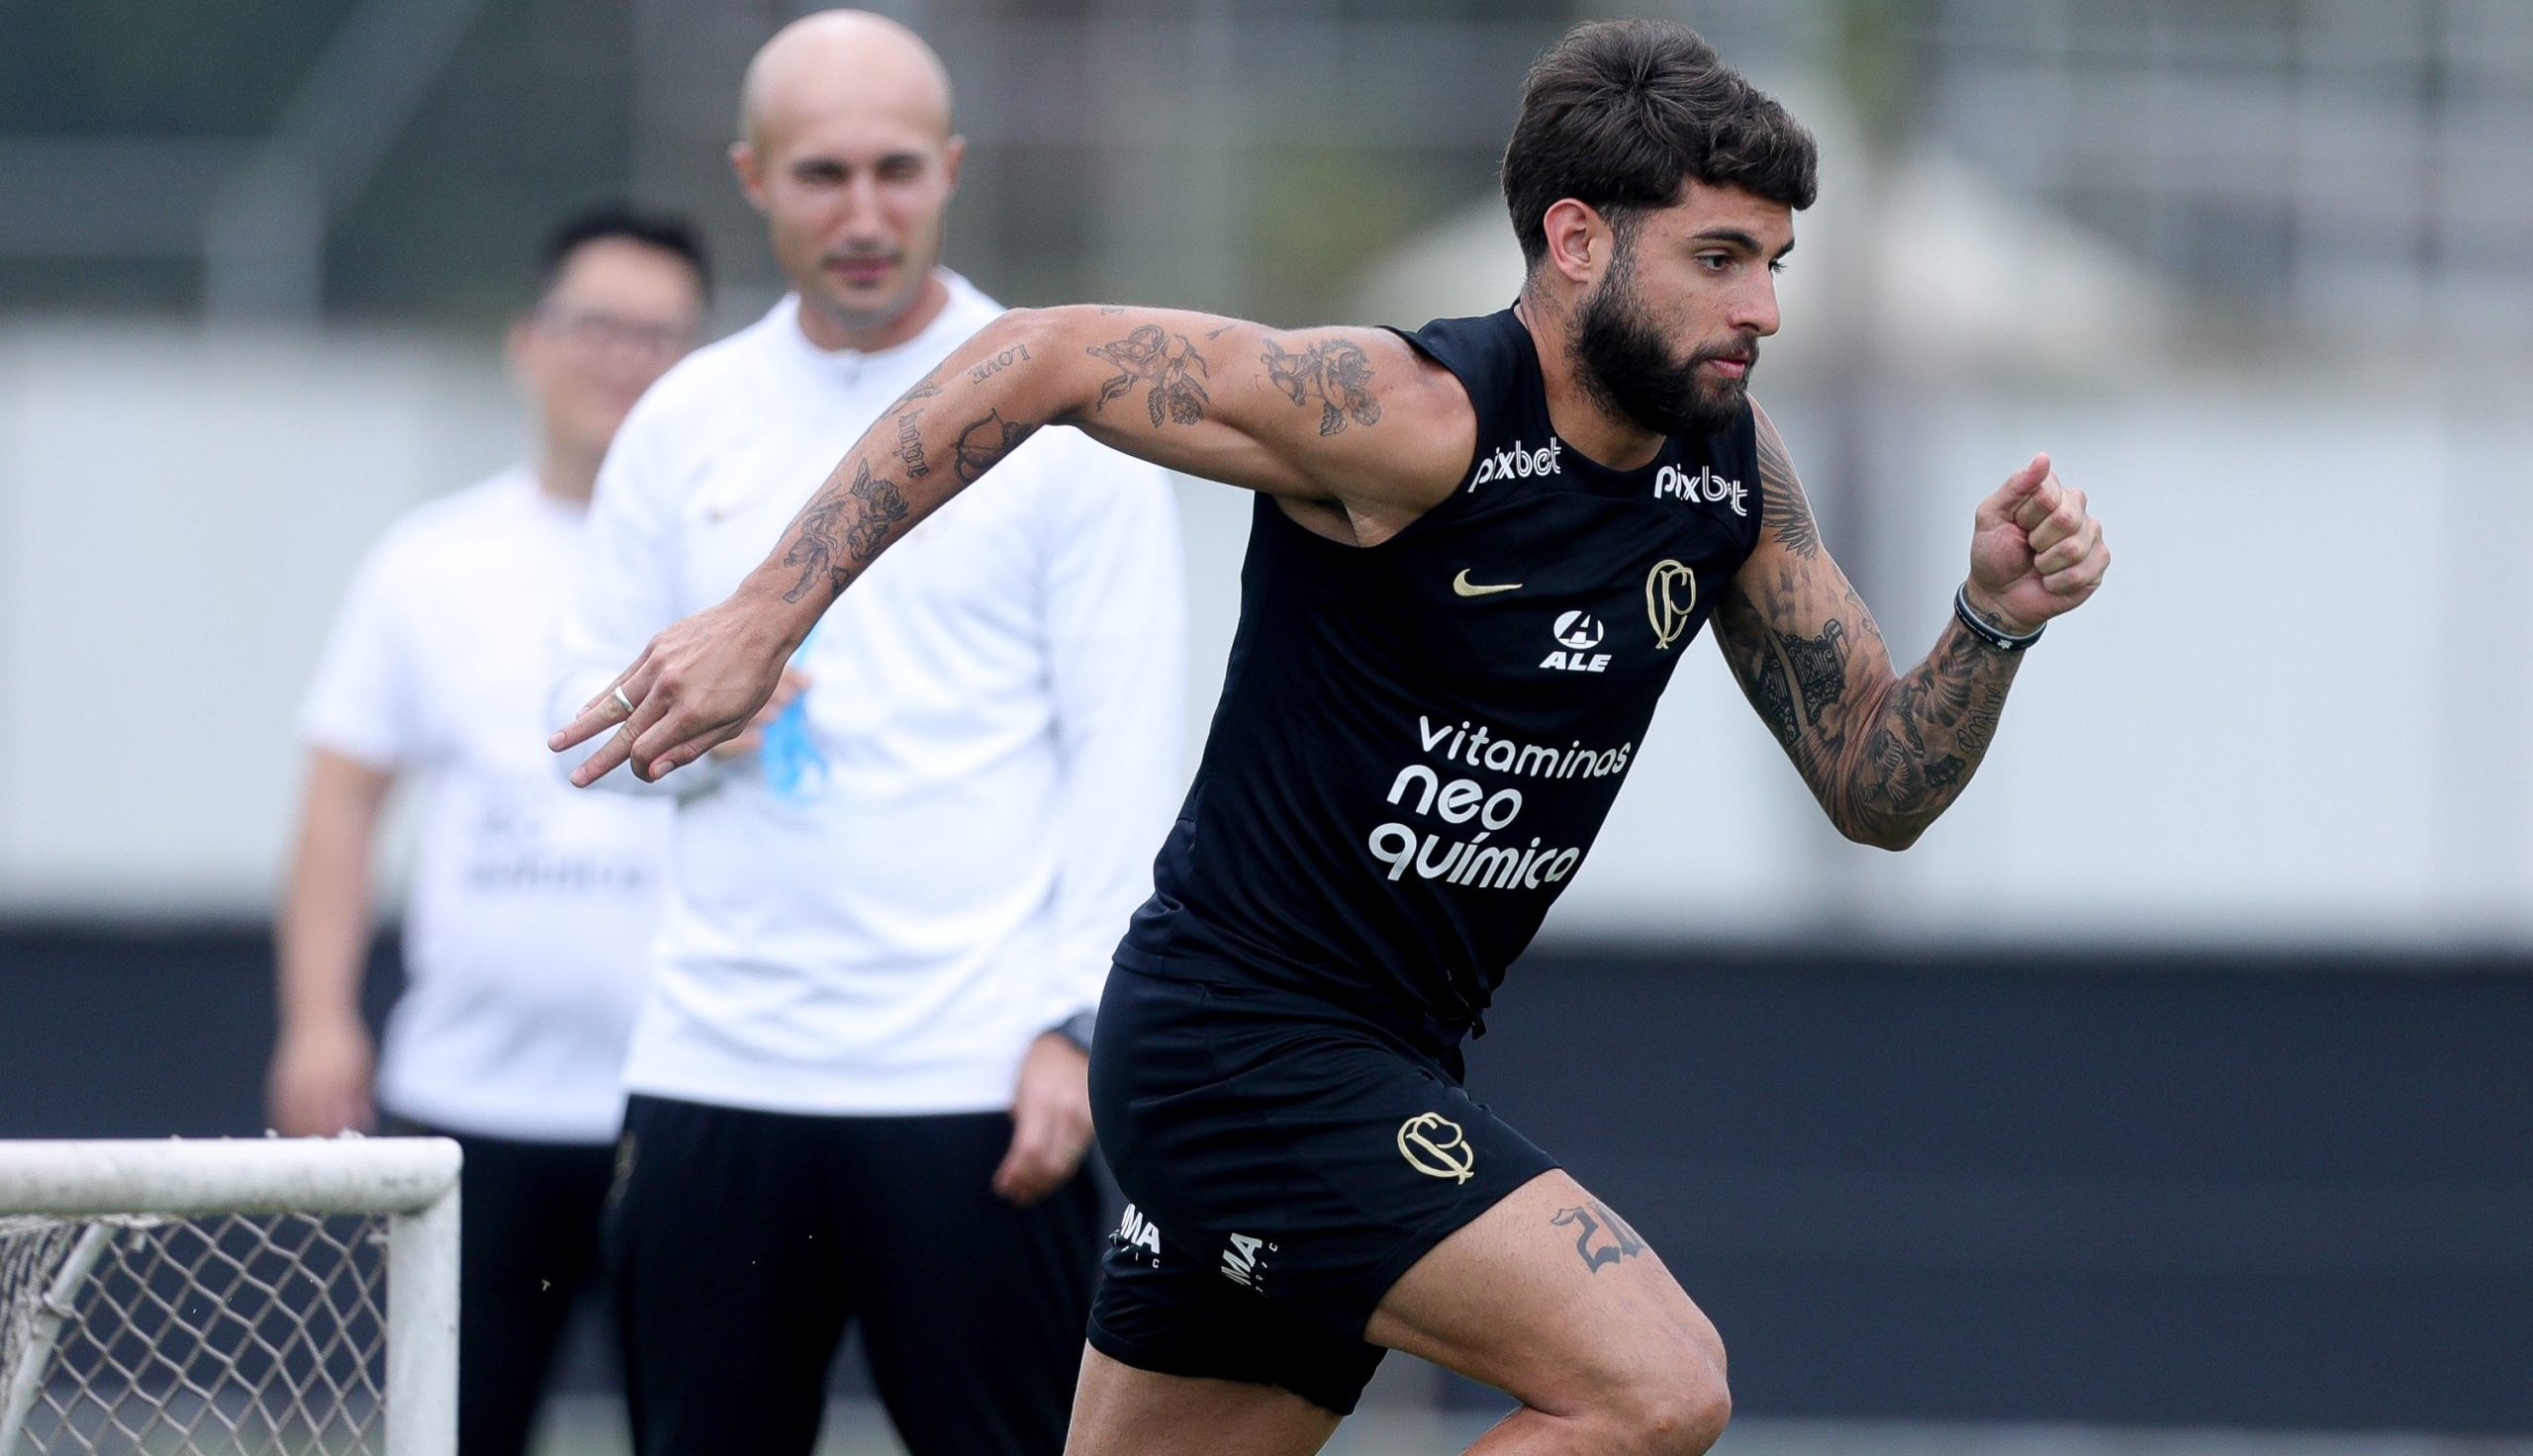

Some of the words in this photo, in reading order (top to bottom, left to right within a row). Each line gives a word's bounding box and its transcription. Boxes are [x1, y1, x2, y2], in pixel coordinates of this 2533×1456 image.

[1467, 436, 1562, 493] pixbet
[1653, 463, 1748, 516] pixbt
[1539, 651, 1613, 673] ALE
[1419, 715, 1632, 779] vitaminas
[1386, 765, 1523, 831] neo
[1368, 822, 1580, 890] química
